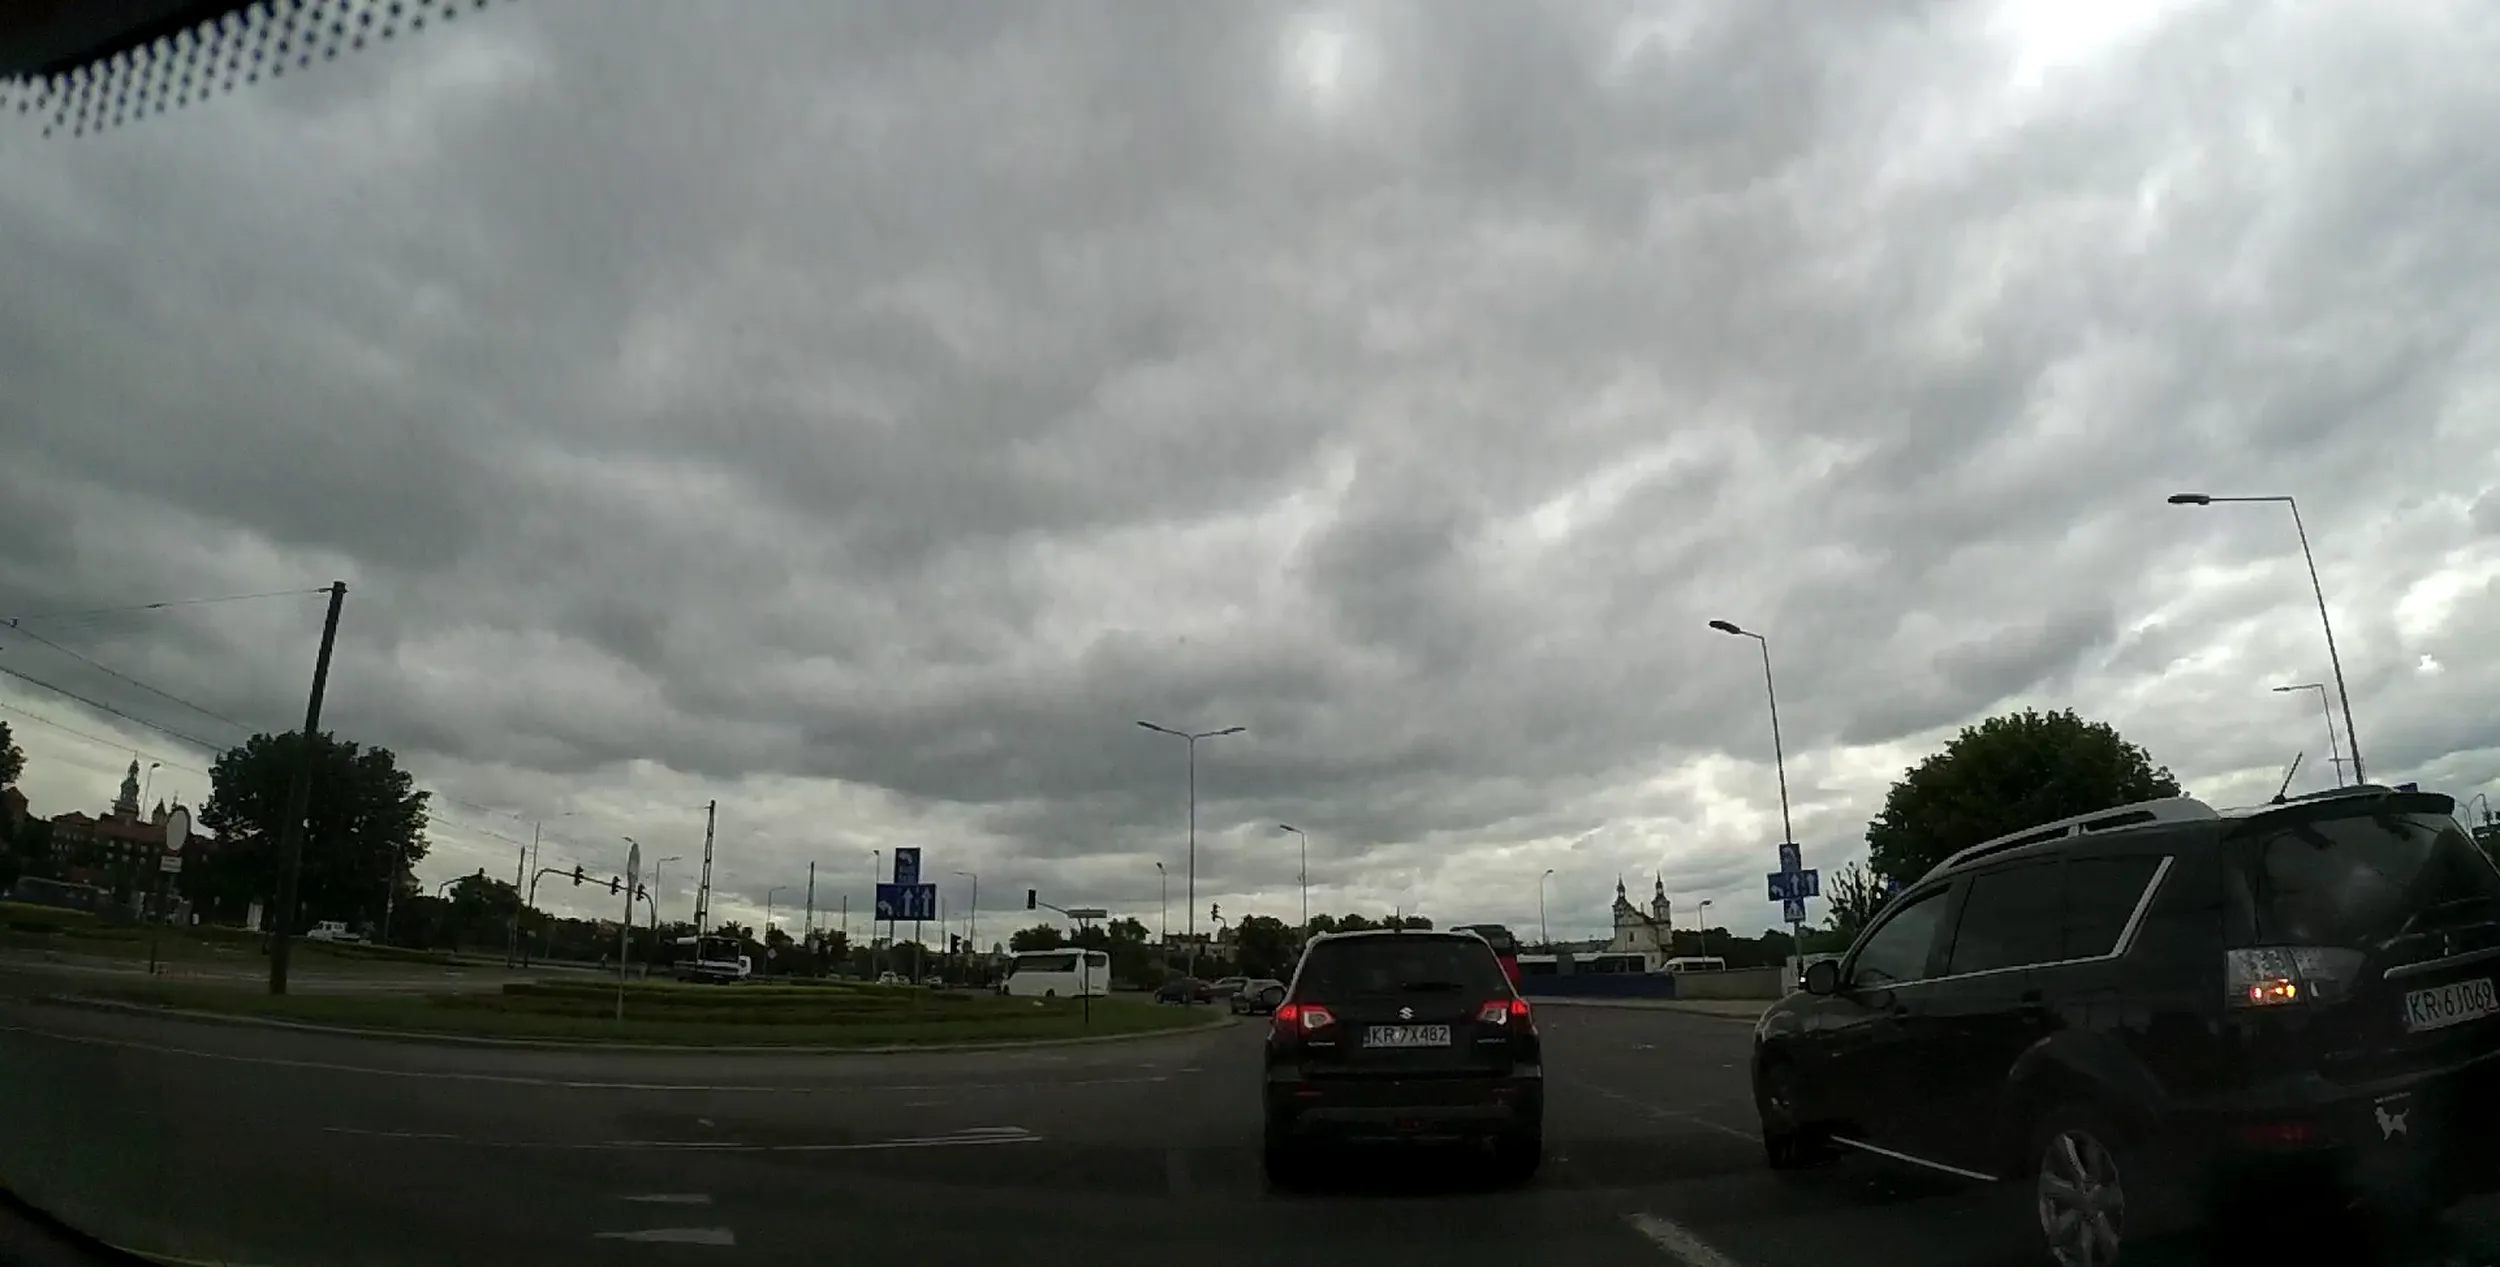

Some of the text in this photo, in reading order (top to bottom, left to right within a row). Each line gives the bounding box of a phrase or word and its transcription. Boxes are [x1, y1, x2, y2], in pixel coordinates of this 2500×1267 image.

[2409, 981, 2491, 1023] KR 6J069
[1371, 1026, 1447, 1044] KR 7X482
